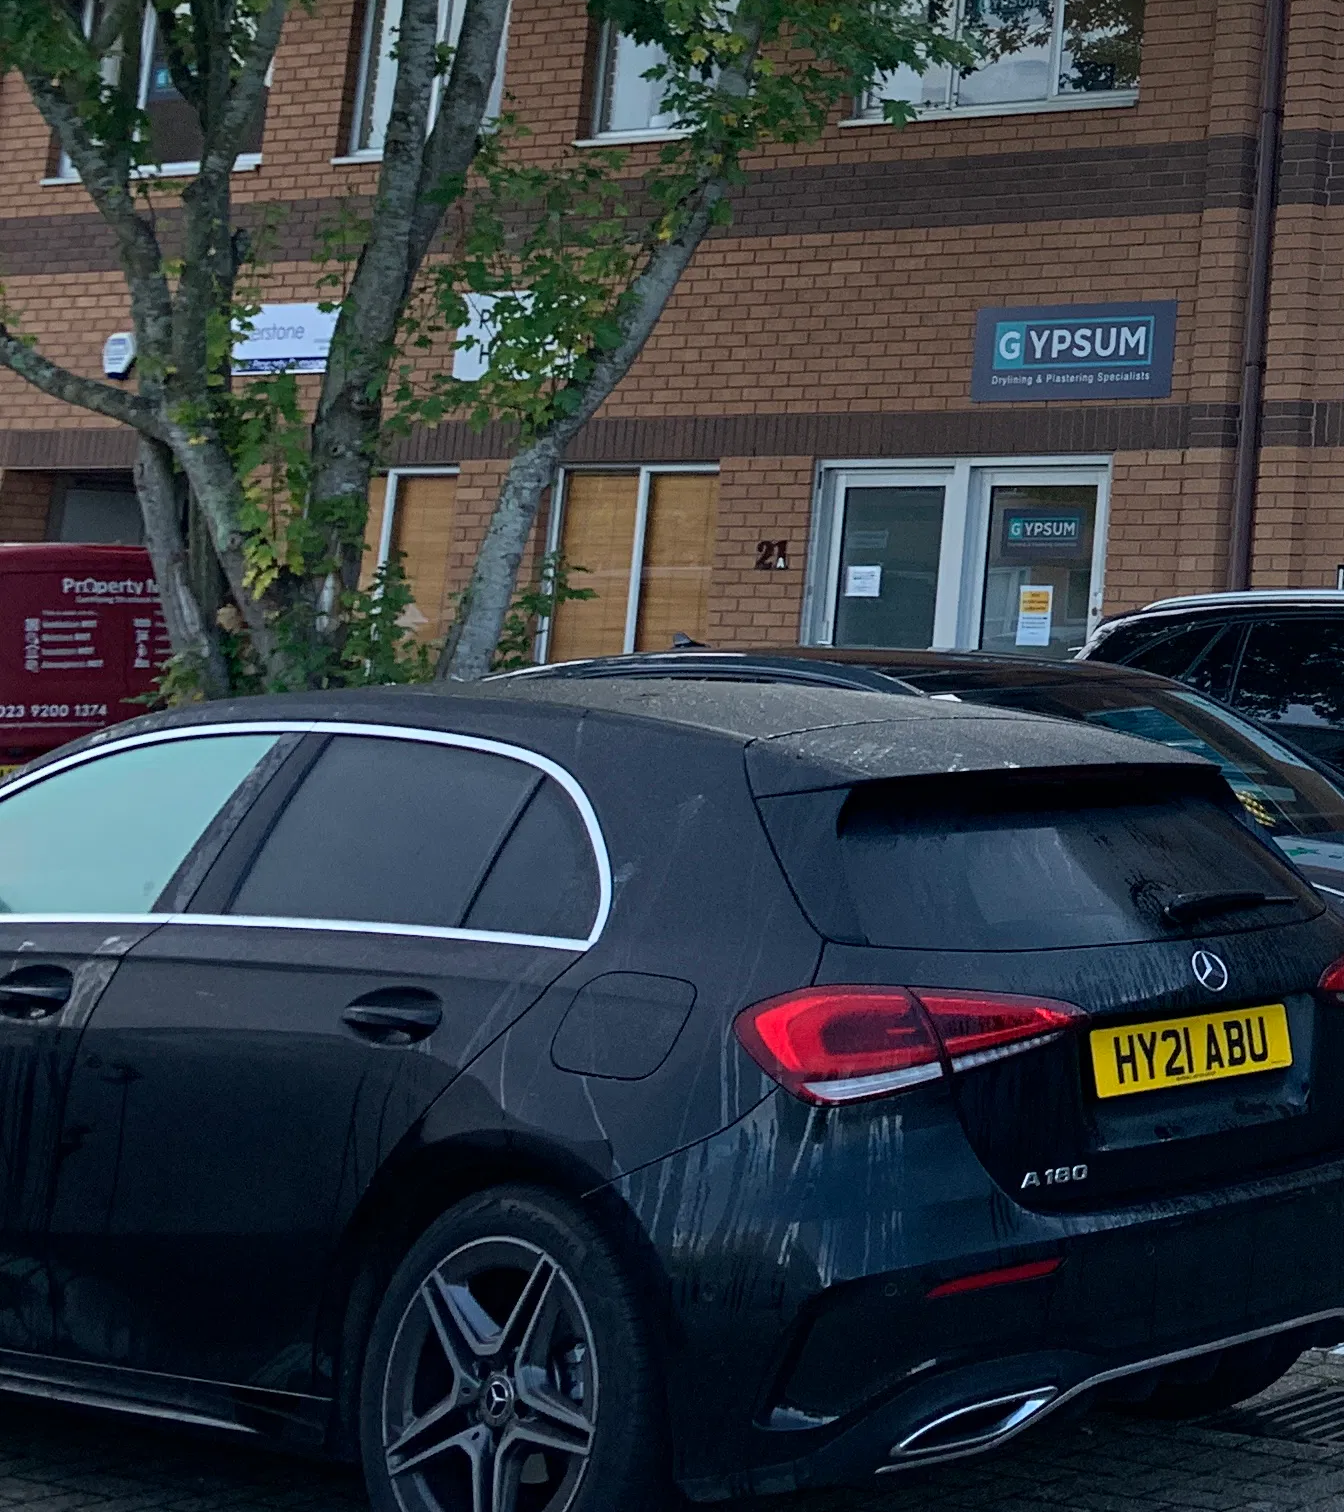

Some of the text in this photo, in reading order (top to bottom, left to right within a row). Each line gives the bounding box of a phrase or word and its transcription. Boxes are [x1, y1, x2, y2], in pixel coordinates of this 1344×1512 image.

[999, 326, 1147, 360] GYPSUM
[991, 370, 1150, 386] Drylining & Plastering Specialists
[1011, 521, 1076, 536] GYPSUM
[31, 704, 70, 717] 9200
[74, 704, 107, 717] 1374
[1113, 1016, 1269, 1085] HY21 ABU
[1044, 1164, 1088, 1185] 180
